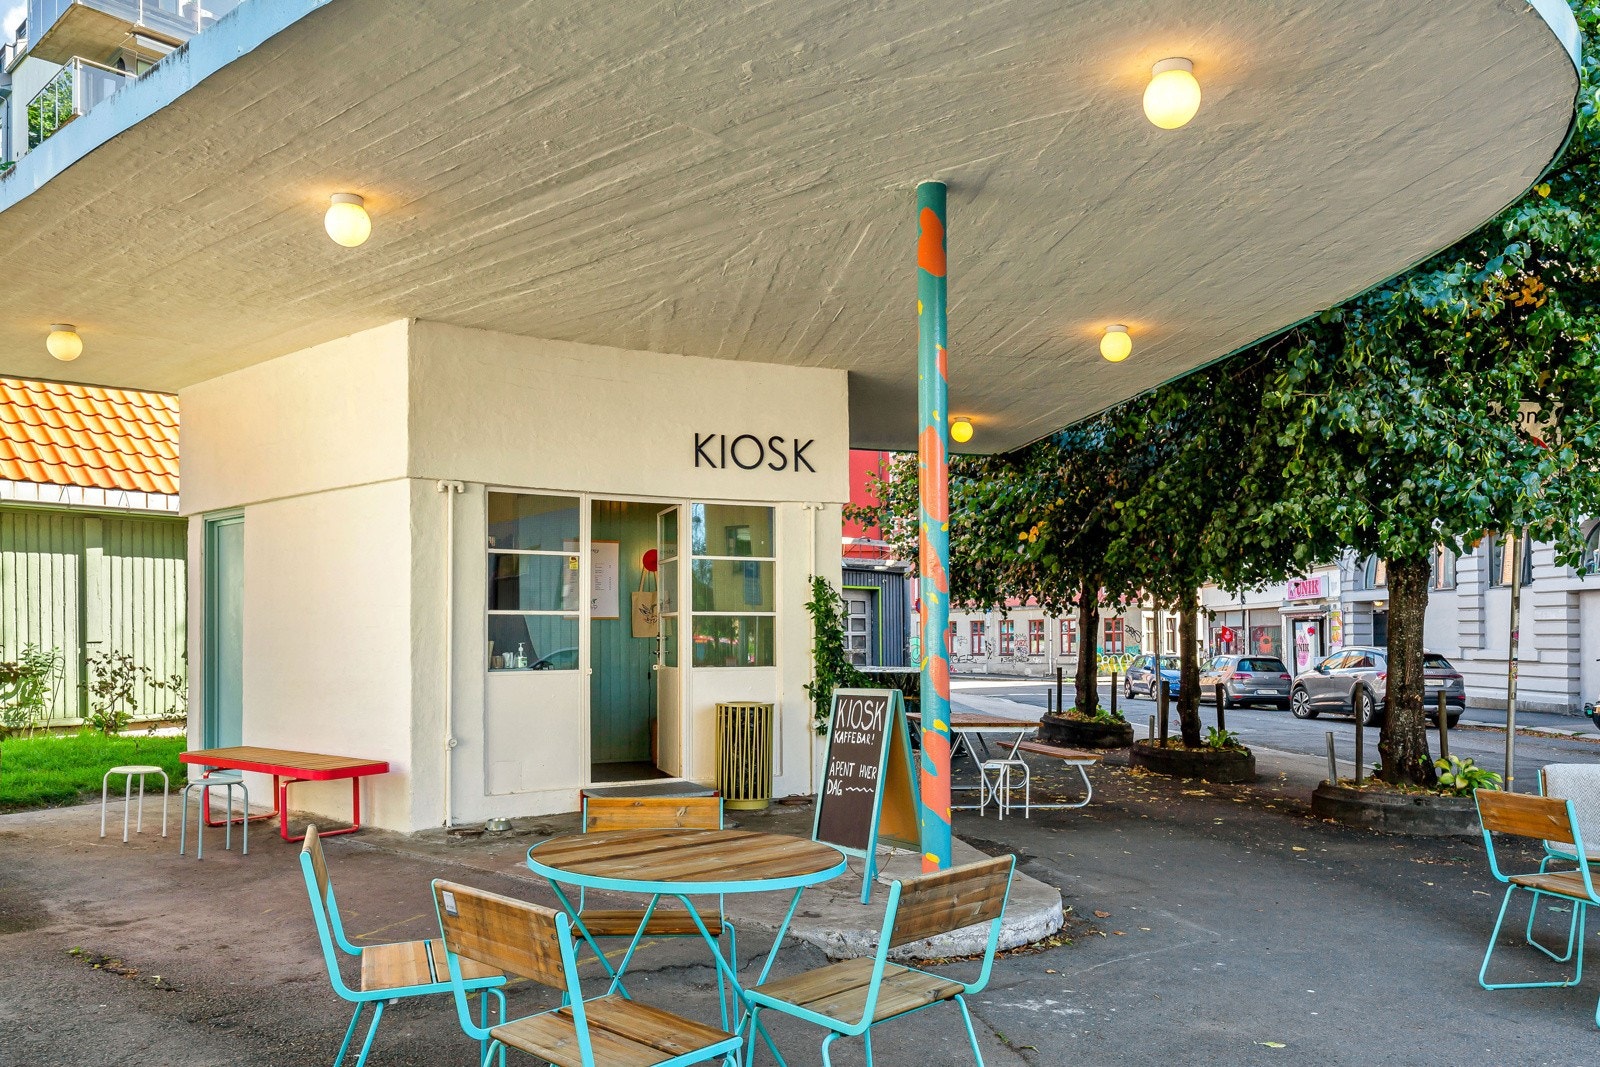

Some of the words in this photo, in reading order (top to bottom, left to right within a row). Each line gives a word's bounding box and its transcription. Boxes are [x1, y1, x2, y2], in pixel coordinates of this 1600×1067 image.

[694, 432, 816, 473] KIOSK
[836, 699, 885, 731] KIOSK
[829, 756, 855, 777] ÅPENT
[826, 779, 843, 796] DAG
